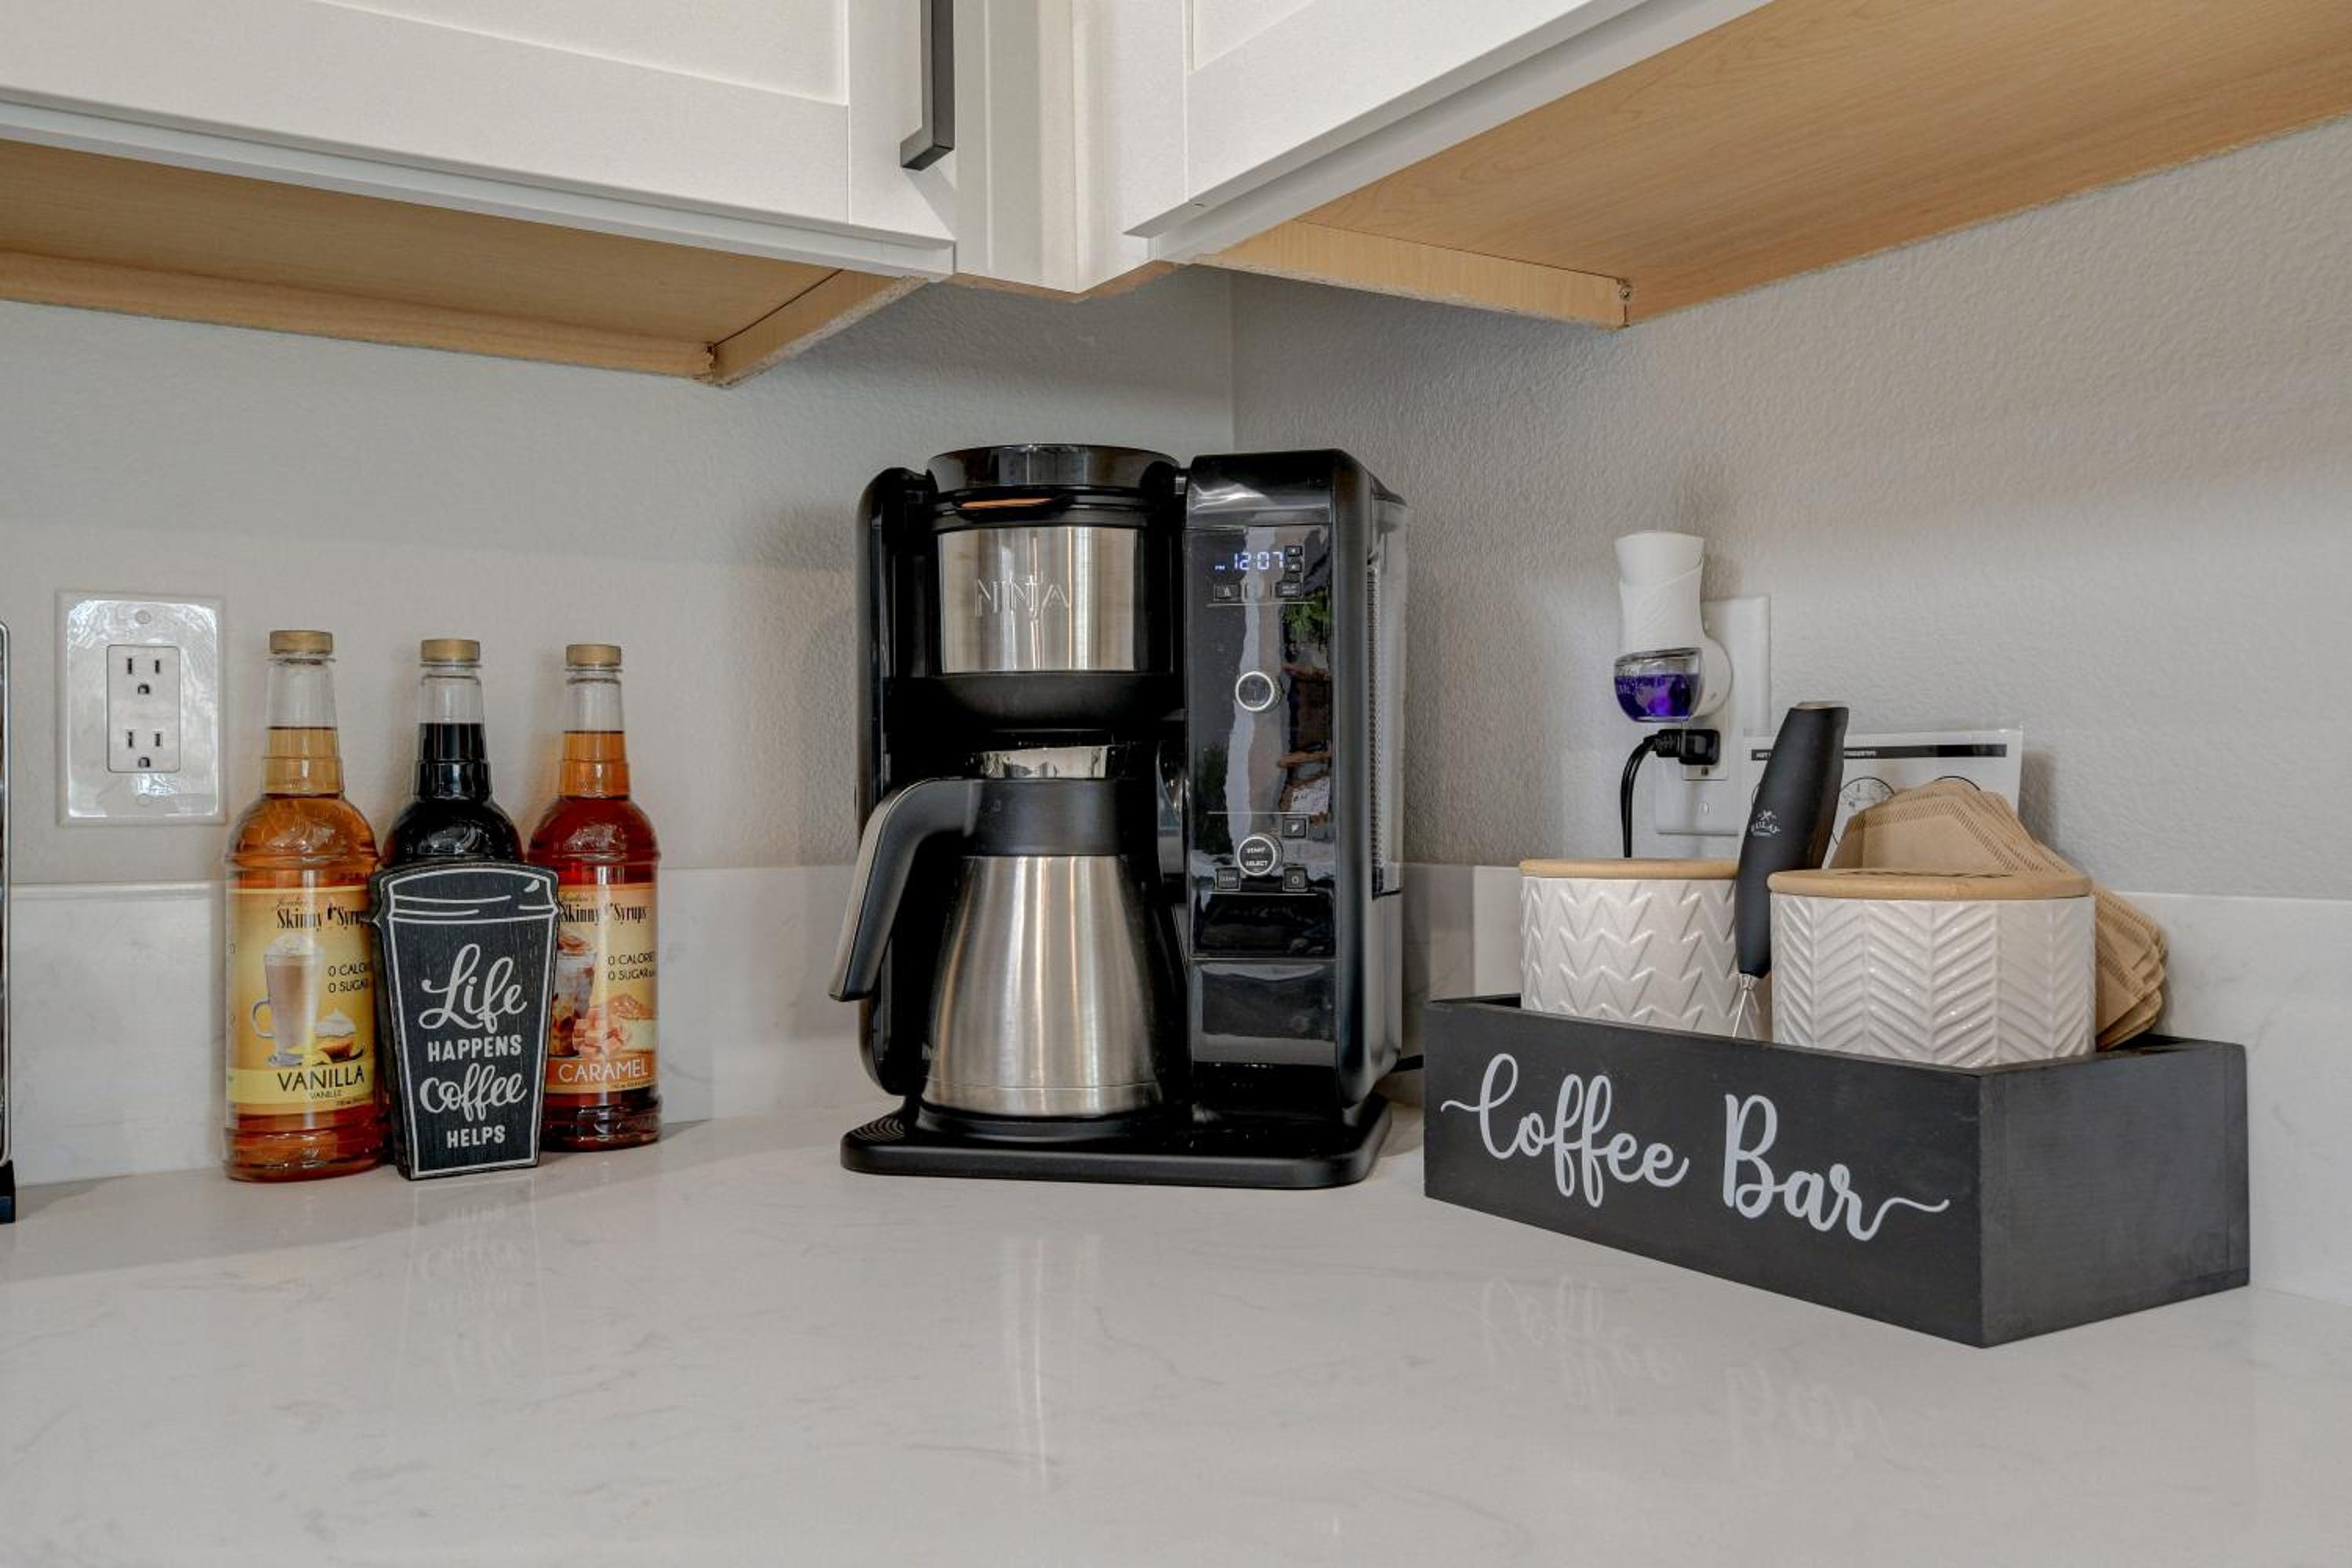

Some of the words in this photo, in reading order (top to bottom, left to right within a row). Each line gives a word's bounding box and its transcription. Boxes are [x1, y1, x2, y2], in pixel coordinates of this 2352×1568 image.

[1233, 551, 1284, 570] 12:07
[974, 576, 1070, 619] NINJA
[277, 907, 322, 931] Skinny
[559, 903, 600, 926] Skinny
[614, 903, 647, 924] Syrups
[419, 943, 528, 1033] Life
[427, 1034, 522, 1062] HAPPENS
[277, 1065, 365, 1092] VANILLA
[558, 1057, 648, 1082] CARAMEL
[446, 1125, 506, 1149] HELPS
[1441, 1053, 1689, 1207] Coffee
[1722, 1094, 1950, 1241] Bar
